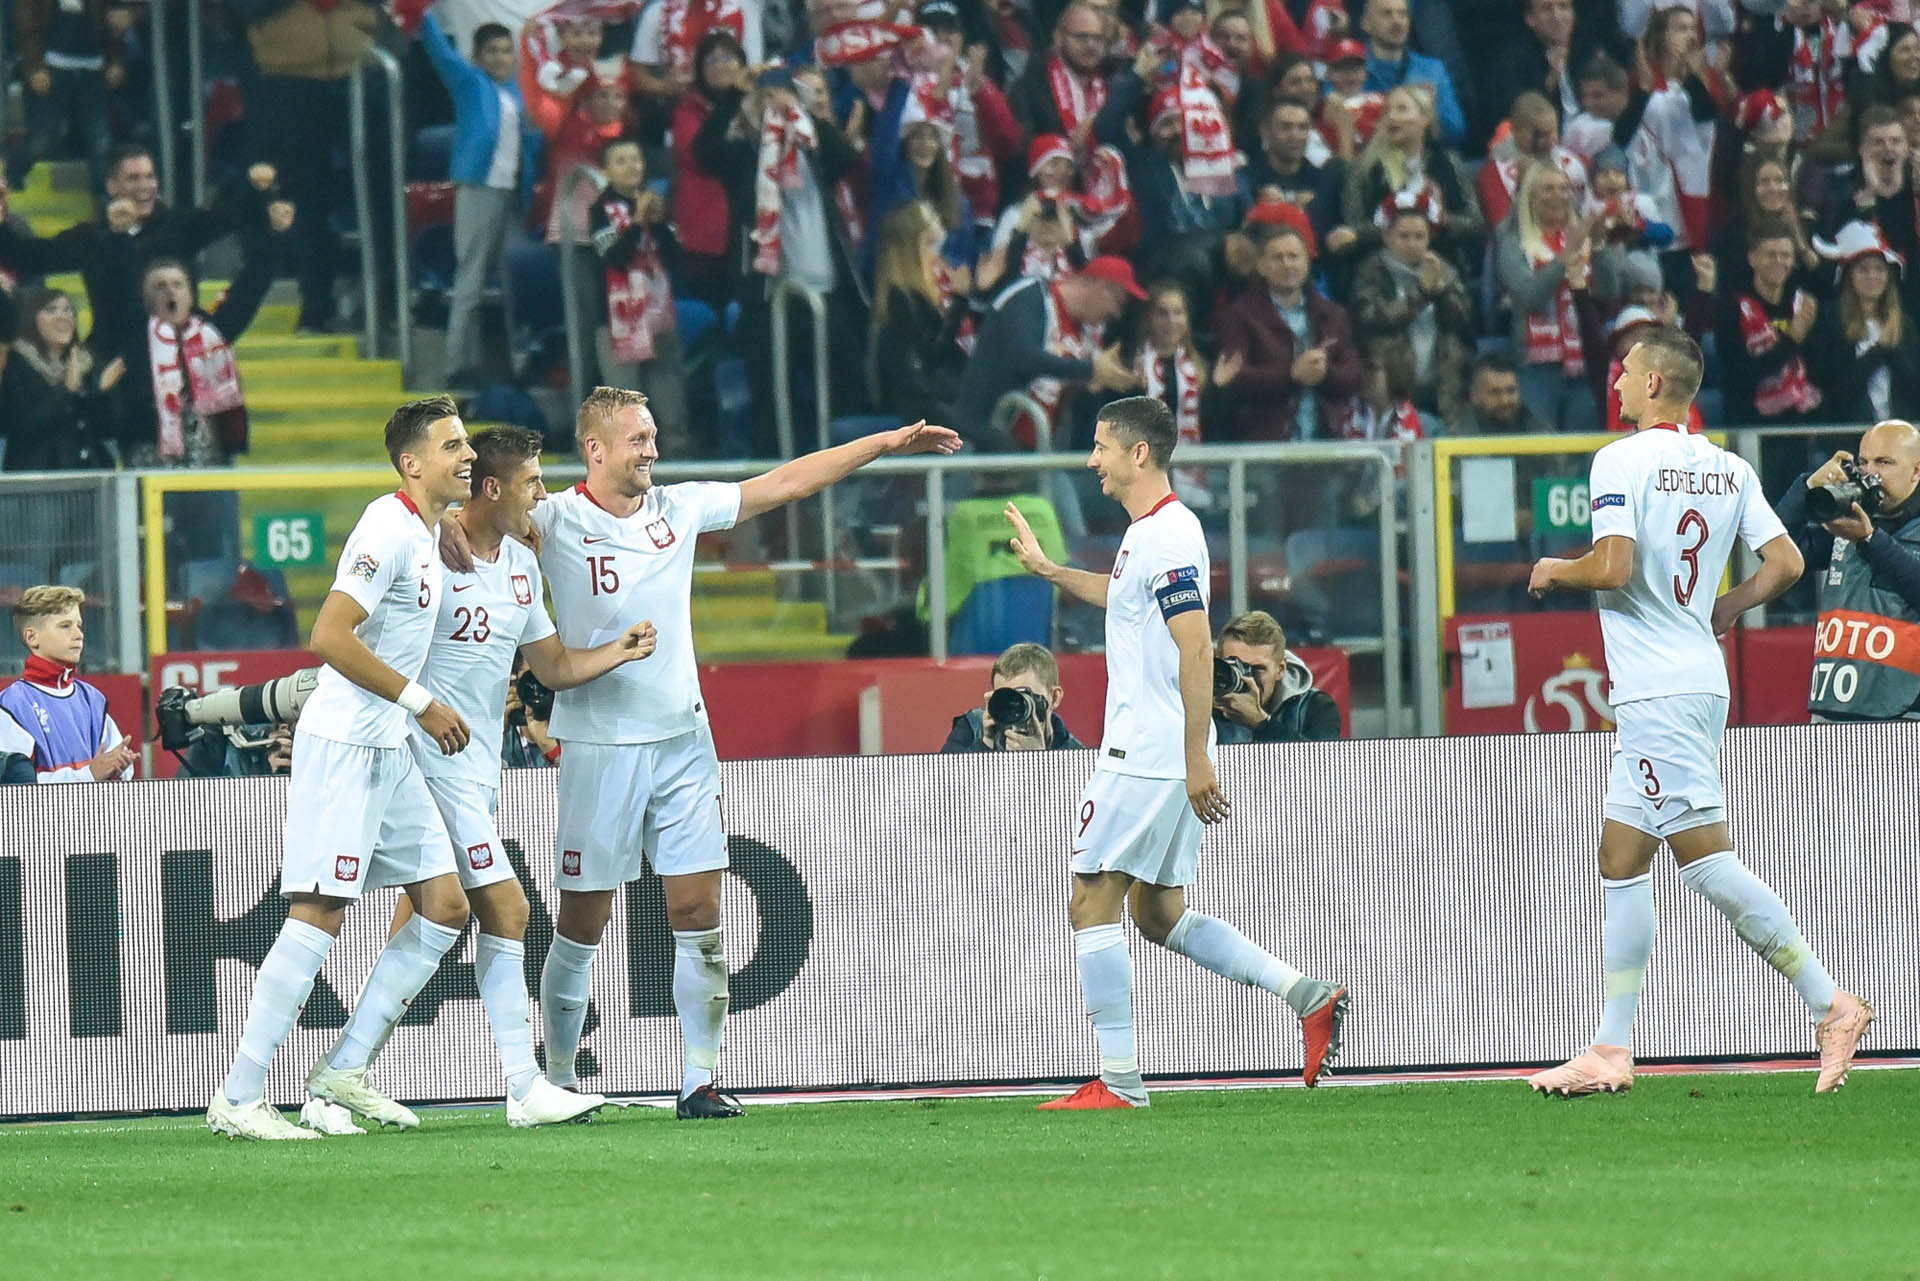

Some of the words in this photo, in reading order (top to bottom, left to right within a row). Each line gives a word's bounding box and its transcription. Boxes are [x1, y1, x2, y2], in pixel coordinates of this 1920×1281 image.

[1547, 484, 1590, 527] 66
[268, 519, 312, 562] 65
[1673, 508, 1709, 607] 3
[418, 577, 431, 608] 5
[586, 556, 620, 596] 15
[449, 606, 491, 643] 23
[1810, 662, 1858, 702] 070
[1639, 758, 1660, 796] 3
[1078, 799, 1095, 838] 9
